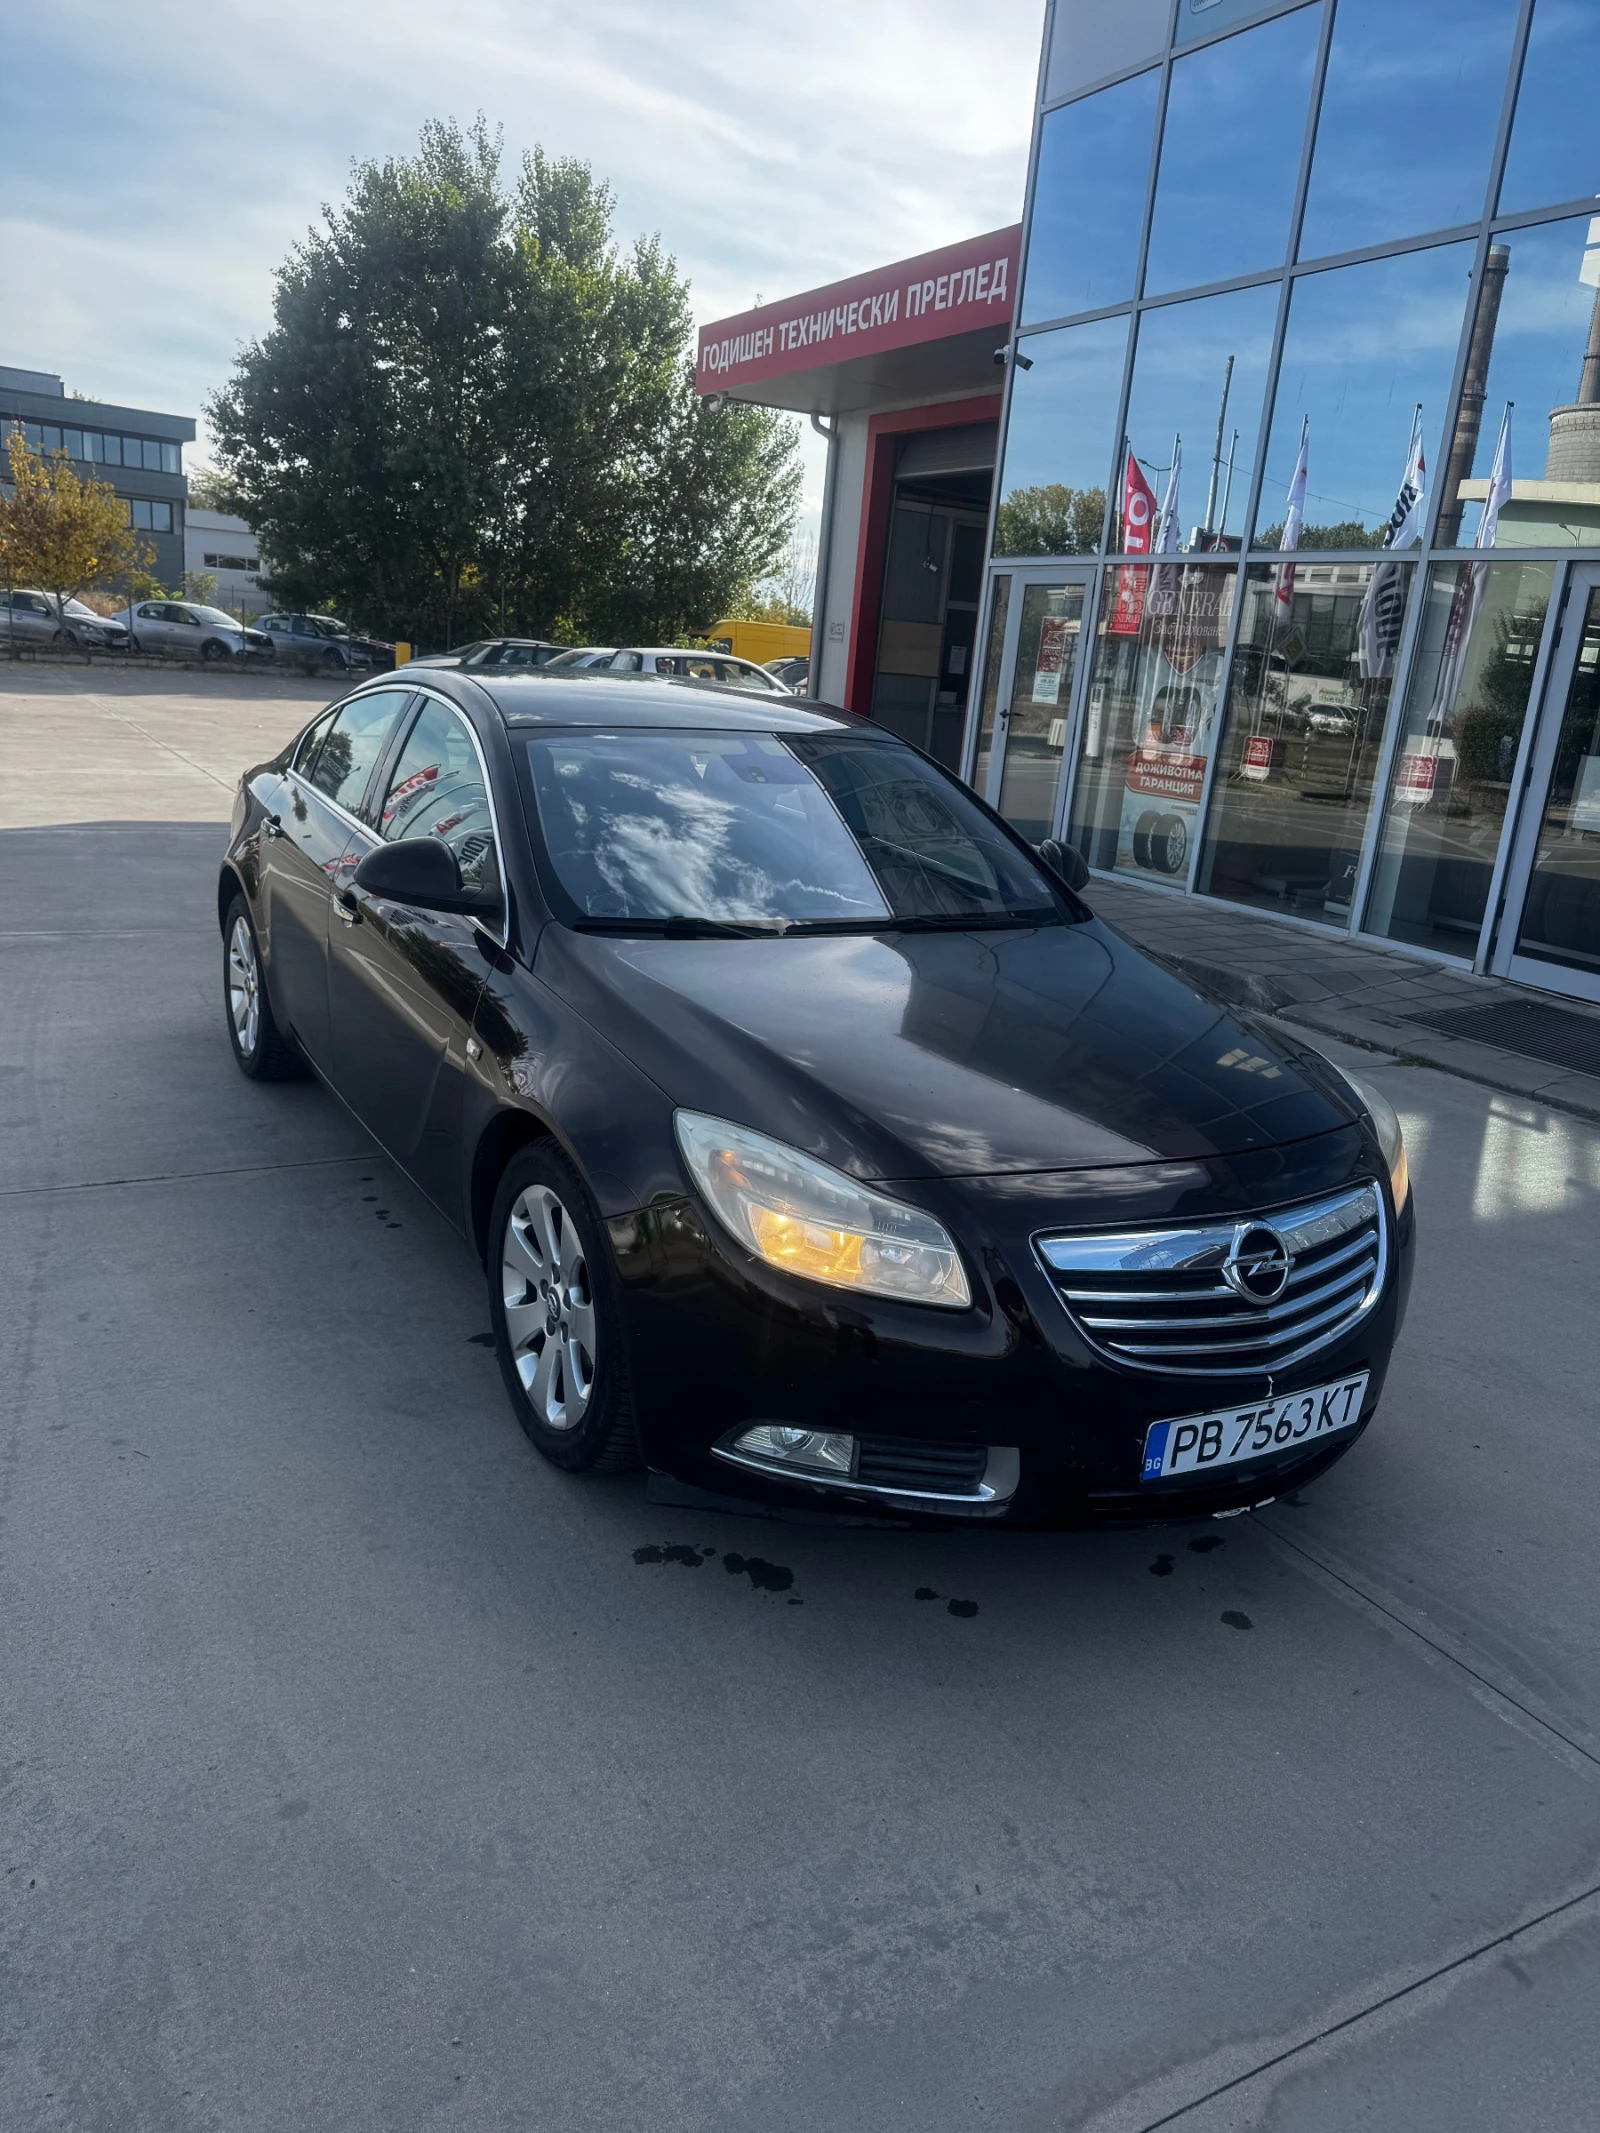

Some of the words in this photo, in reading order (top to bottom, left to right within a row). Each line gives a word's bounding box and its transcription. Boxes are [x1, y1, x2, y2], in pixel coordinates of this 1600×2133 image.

[702, 326, 774, 374] ГОДИШЕН
[779, 289, 900, 352] ТЕХНИЧЕСКИ
[905, 257, 1009, 319] ПРЕГЛЕД
[1135, 762, 1203, 781] ДОЖИВОТНА
[1140, 776, 1195, 795] ГАРАНЦИЯ
[1144, 1457, 1161, 1472] BG
